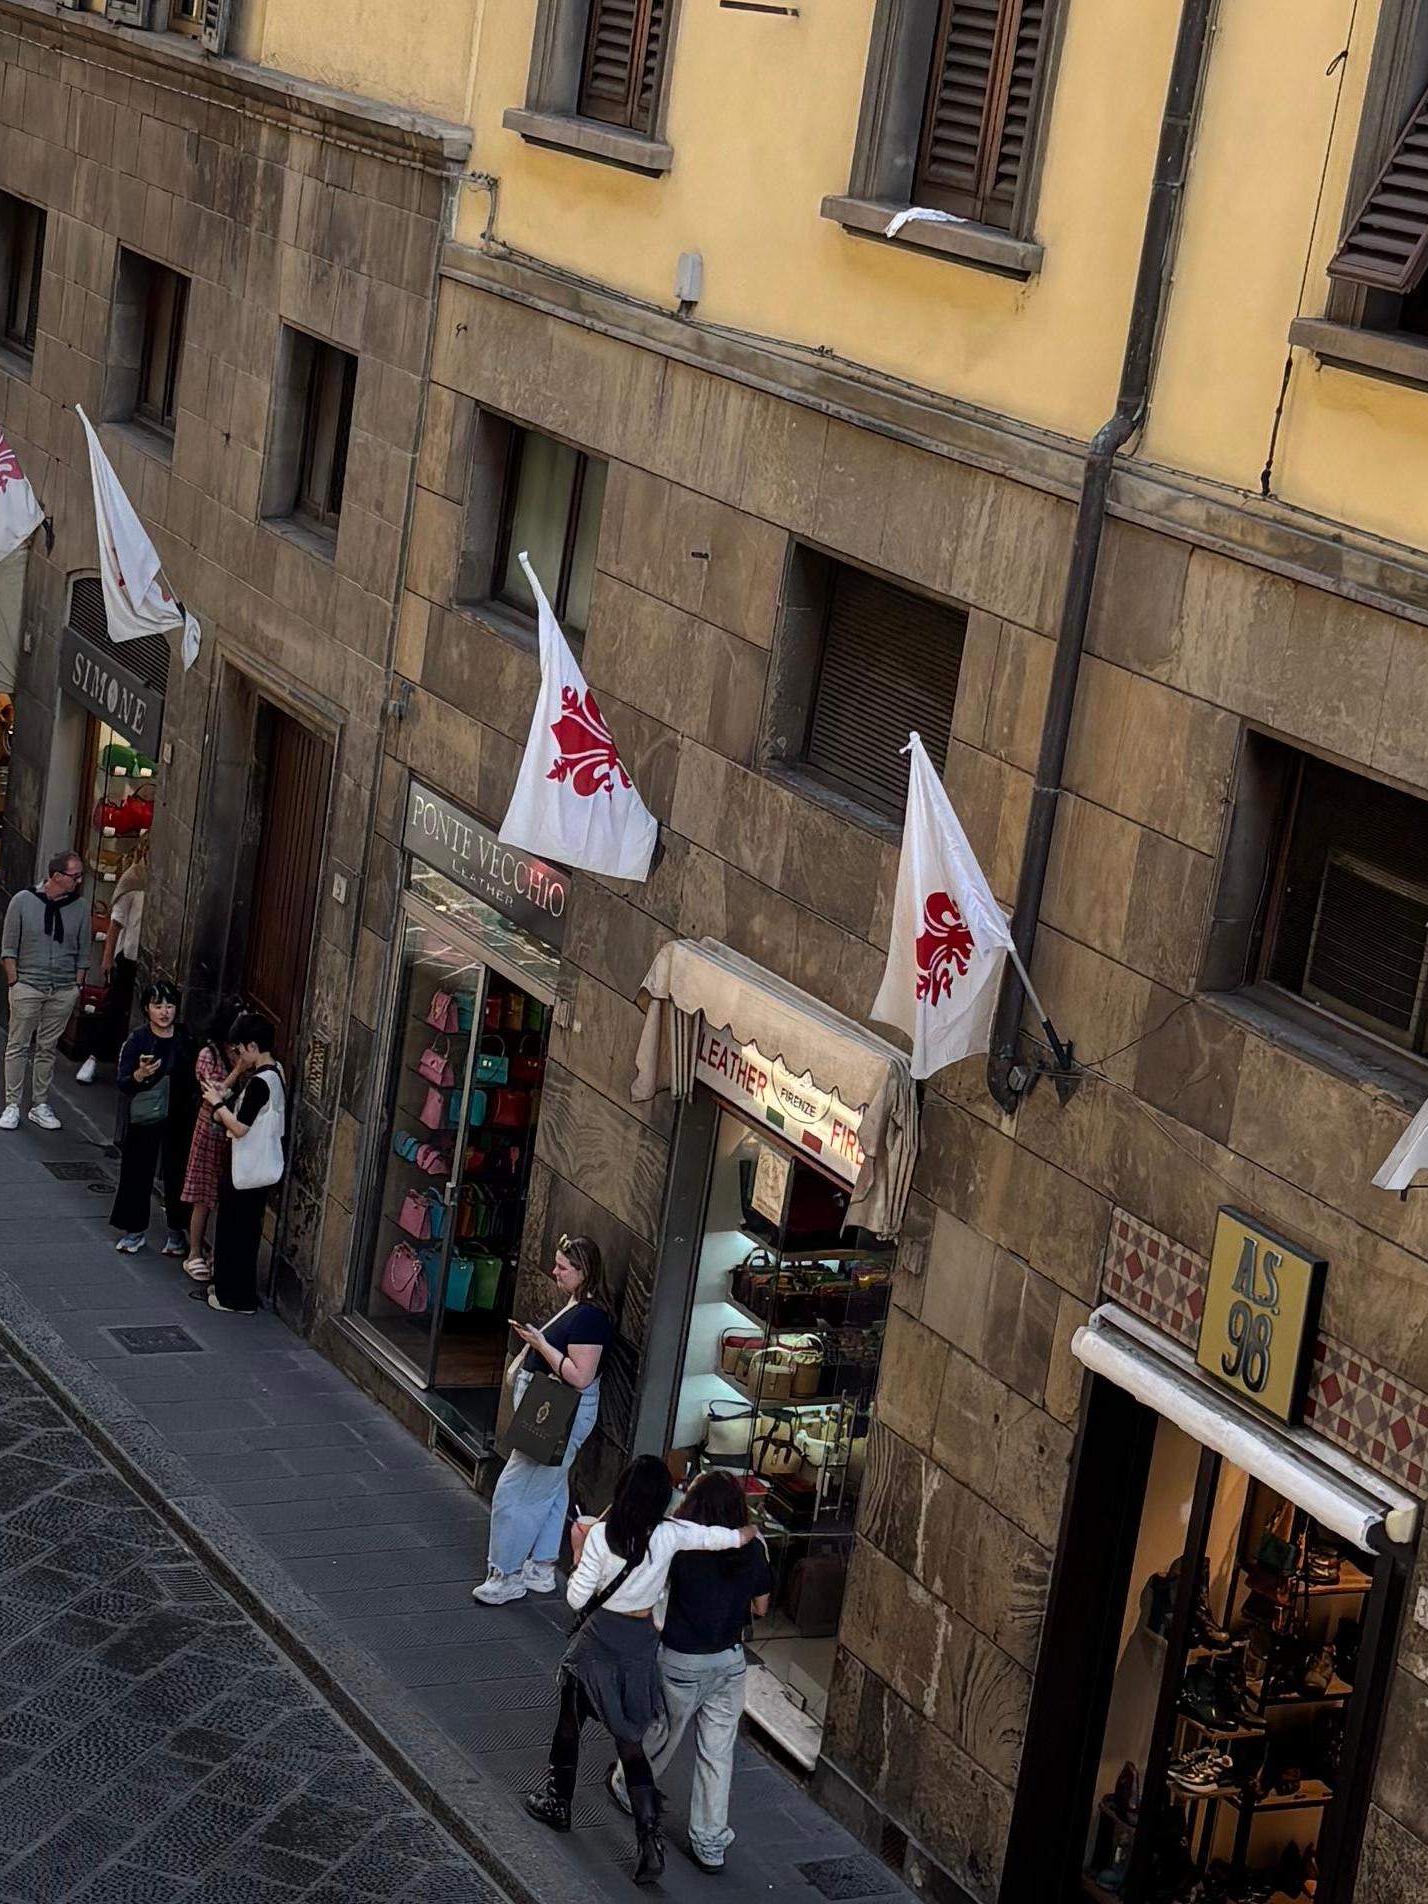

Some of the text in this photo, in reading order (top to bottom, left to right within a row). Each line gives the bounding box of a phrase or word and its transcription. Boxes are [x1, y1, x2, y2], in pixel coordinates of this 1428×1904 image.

[72, 651, 148, 736] SIMONE
[411, 795, 565, 918] PONTE VECCHIO
[451, 858, 514, 908] LEATHER
[698, 1032, 768, 1102] LEATHER
[779, 1087, 818, 1118] FIRENZE
[1221, 1300, 1273, 1393] 98
